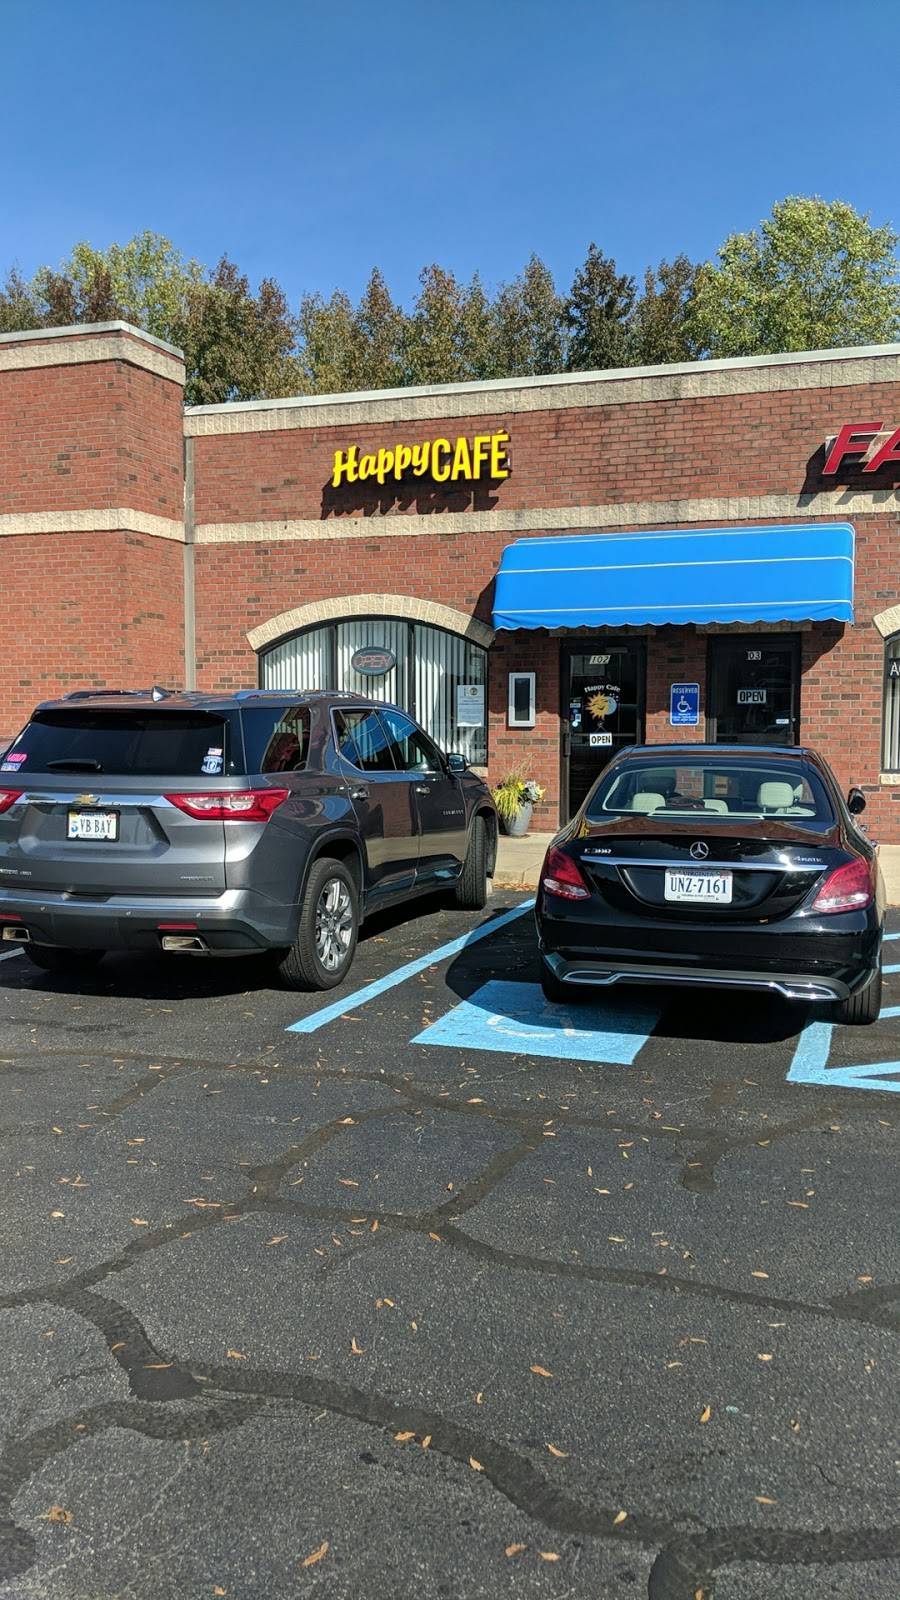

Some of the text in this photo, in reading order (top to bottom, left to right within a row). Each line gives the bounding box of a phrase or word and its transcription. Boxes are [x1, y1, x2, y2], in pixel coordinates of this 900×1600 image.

[332, 442, 430, 487] Happy
[584, 685, 605, 693] Happy
[740, 690, 764, 702] OPEN
[591, 736, 611, 744] OPEN
[94, 819, 111, 833] BAY
[670, 876, 727, 894] UNZ-7161
